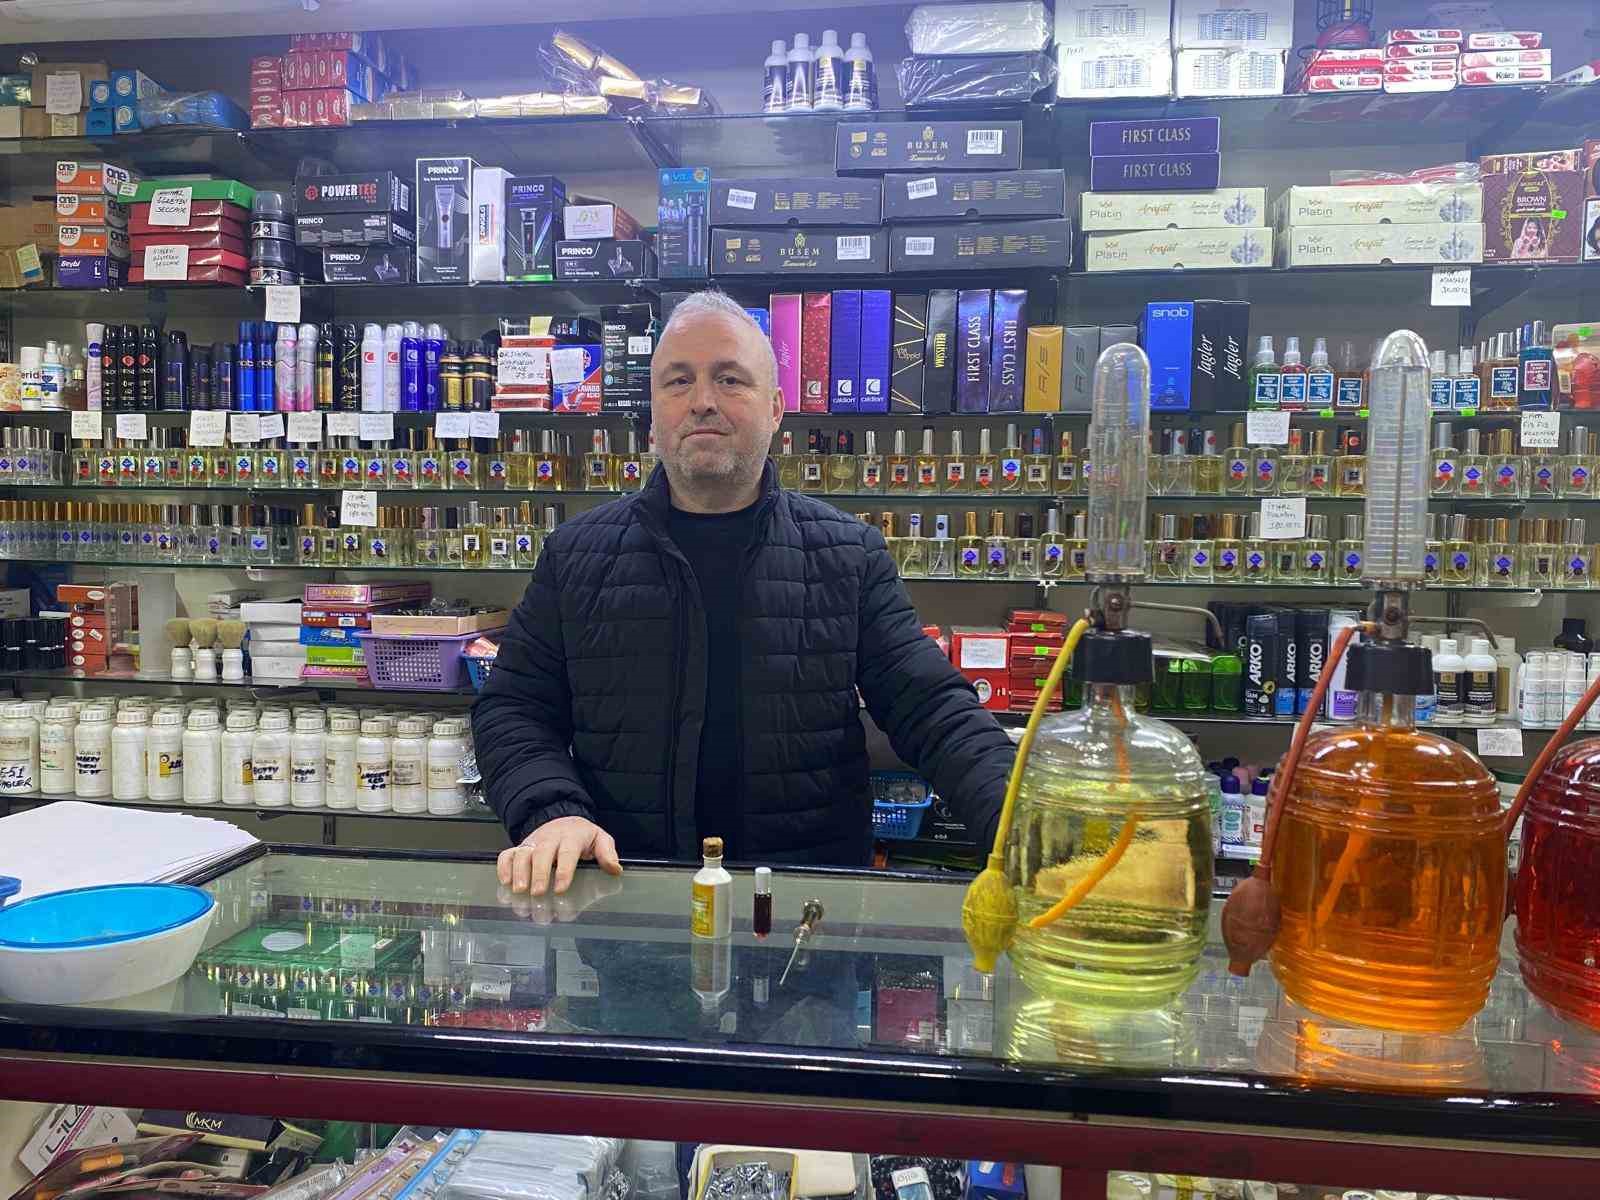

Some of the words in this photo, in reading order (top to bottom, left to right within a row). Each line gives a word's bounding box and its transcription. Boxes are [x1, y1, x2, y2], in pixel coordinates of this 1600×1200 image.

[1122, 129, 1153, 144] FIRST
[1158, 127, 1191, 142] CLASS
[907, 141, 948, 150] BUSEM
[58, 163, 75, 171] one
[428, 166, 459, 175] PRINCO
[1123, 164, 1154, 178] FIRST
[1158, 162, 1192, 177] CLASS
[89, 176, 96, 184] L
[107, 168, 127, 182] one
[321, 184, 377, 198] POWERTEC
[512, 184, 545, 193] PRINCO
[58, 195, 77, 204] one
[90, 207, 97, 216] L
[1298, 207, 1333, 217] Platin
[297, 217, 324, 225] PRINCO
[61, 227, 78, 235] one
[93, 238, 100, 248] L
[780, 248, 820, 256] BUSEM
[1298, 244, 1333, 254] Platin
[330, 253, 361, 261] PRINCO
[94, 266, 101, 276] L
[1152, 306, 1190, 318] snob
[967, 315, 982, 348] CLASS
[1003, 319, 1018, 350] FIRST
[1196, 333, 1217, 379] Jagler
[1223, 335, 1242, 380] Jagler
[967, 353, 982, 383] FIRST
[1001, 352, 1016, 386] CLASS
[1249, 643, 1262, 686] ARKO
[1286, 642, 1297, 683] ARKO
[1308, 643, 1322, 682] ARKO
